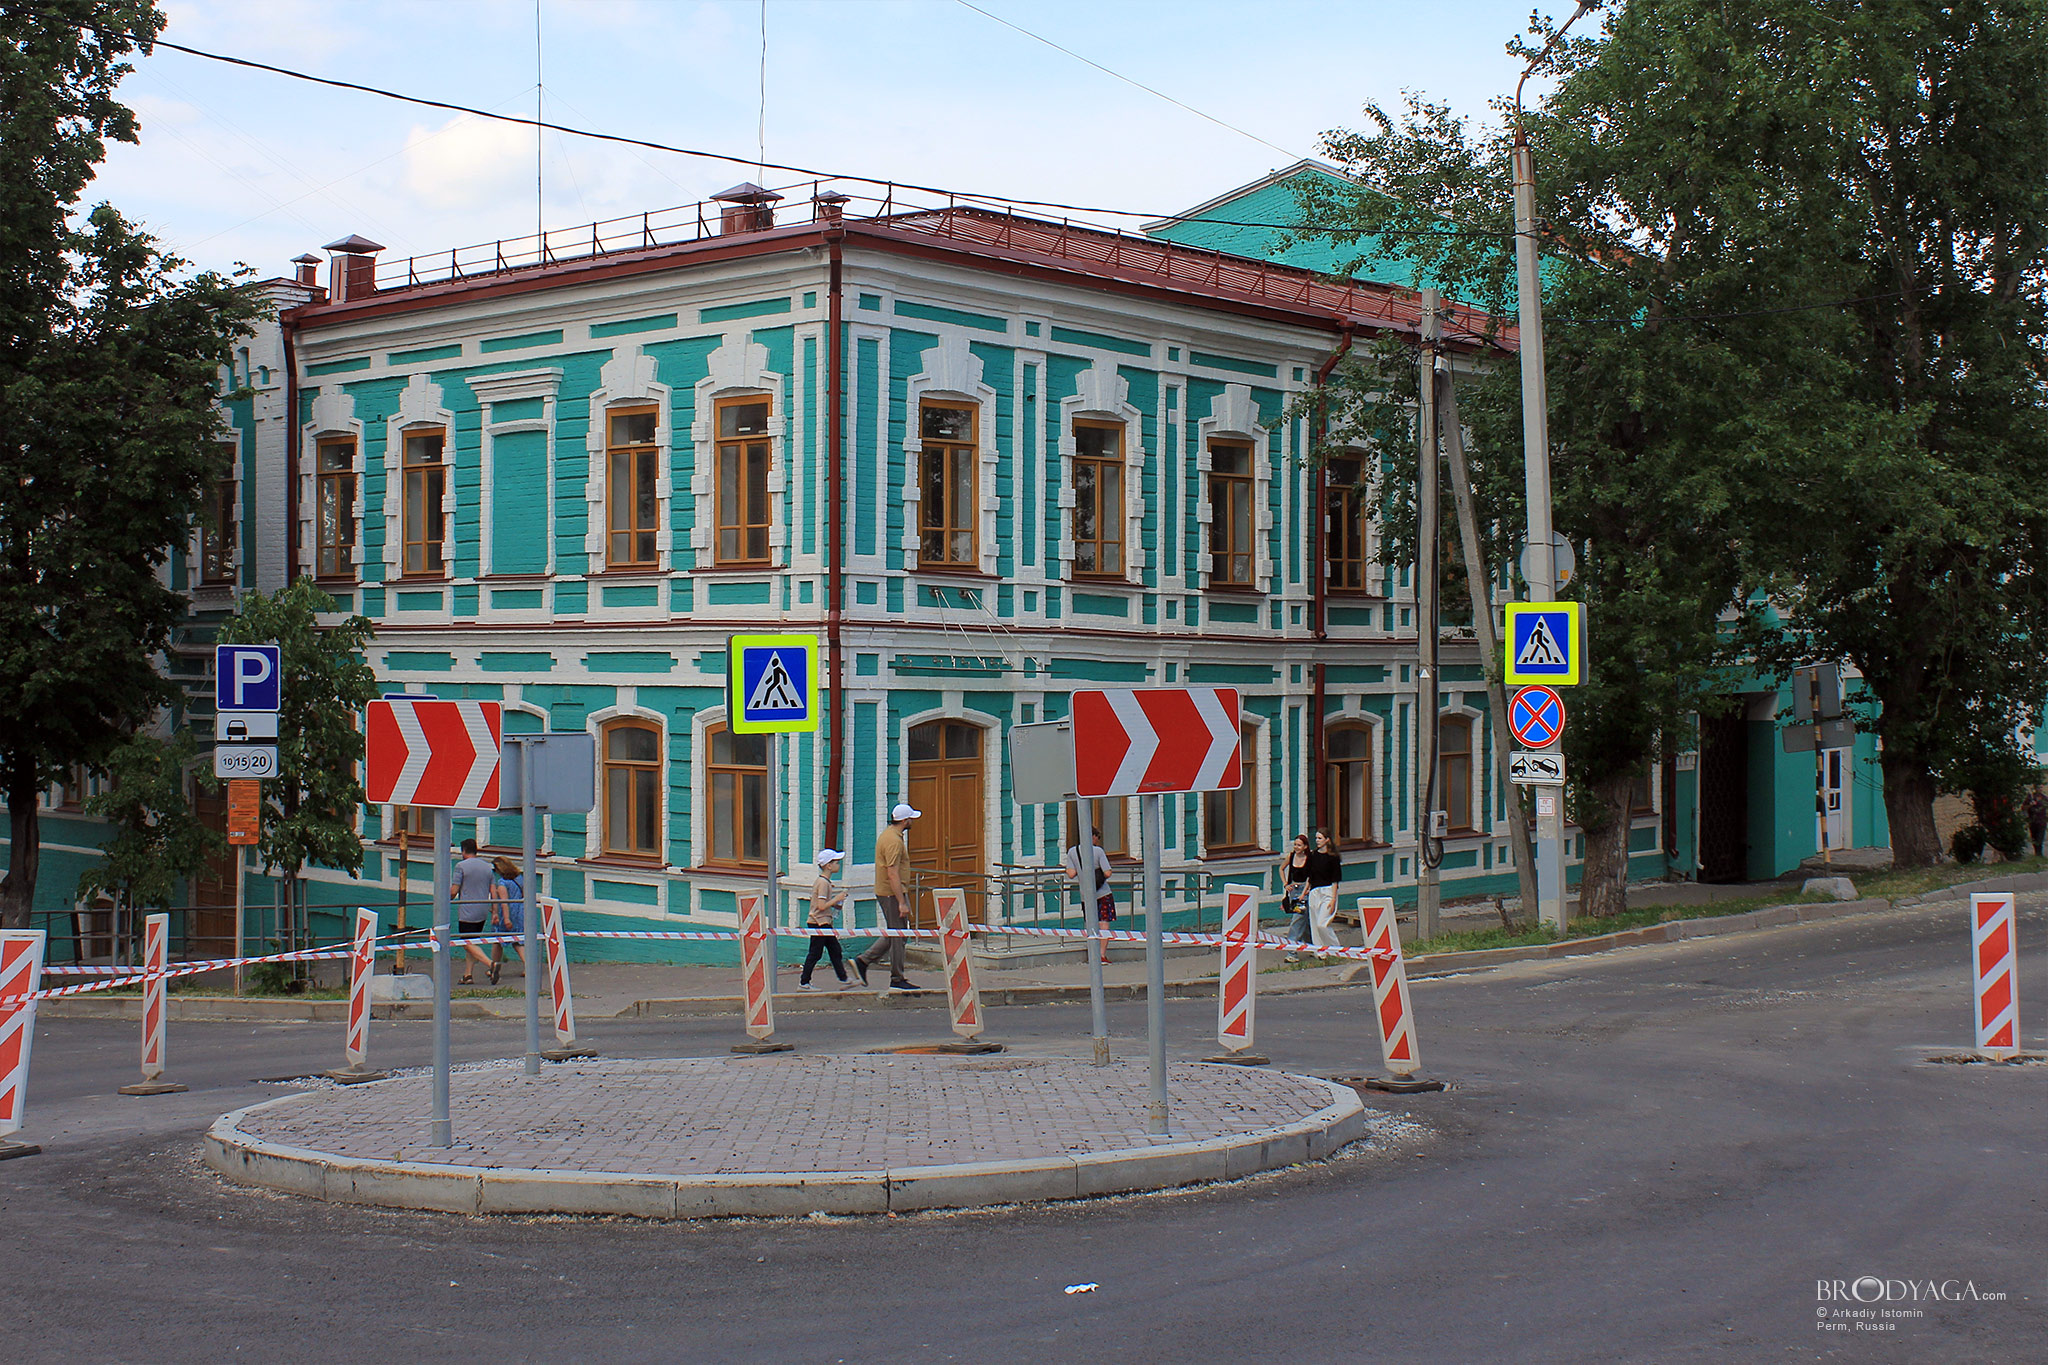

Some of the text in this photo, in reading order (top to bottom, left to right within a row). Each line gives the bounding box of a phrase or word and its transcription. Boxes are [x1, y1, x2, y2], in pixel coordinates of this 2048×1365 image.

[234, 651, 271, 704] P
[223, 756, 267, 767] 10 15 20
